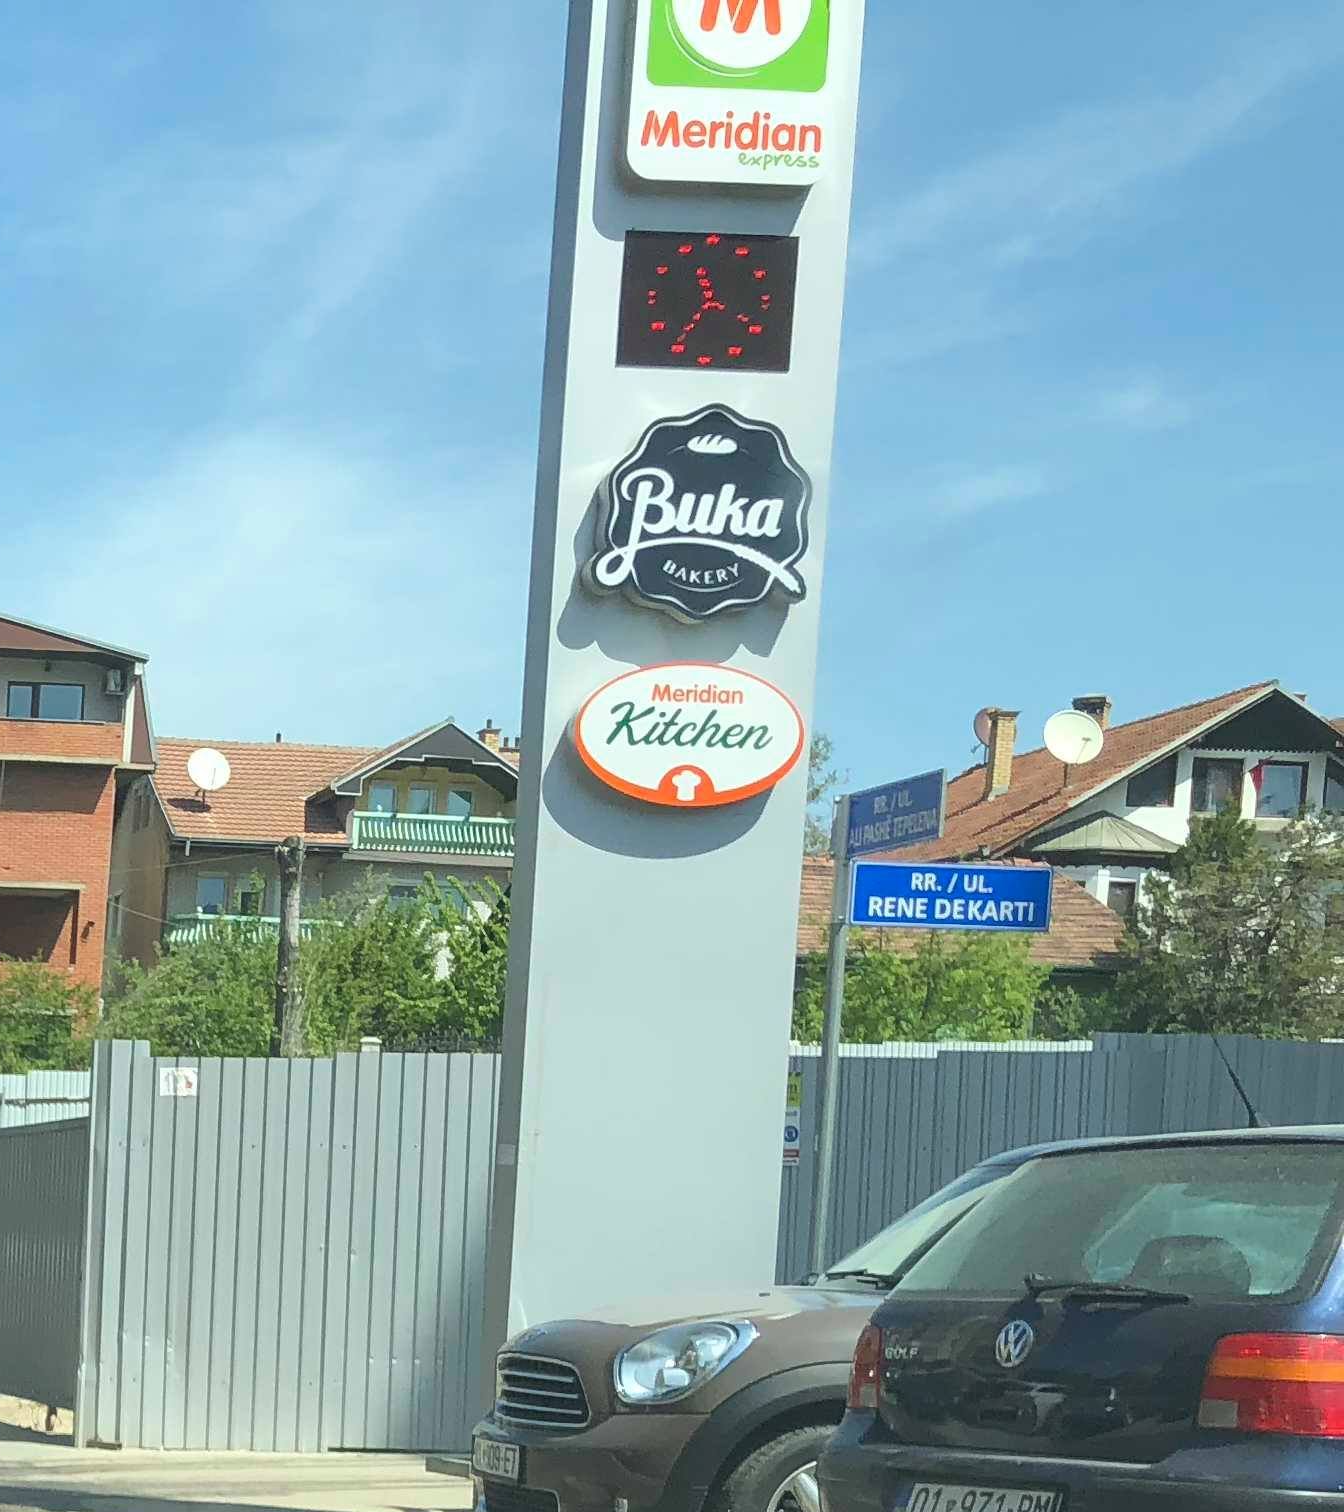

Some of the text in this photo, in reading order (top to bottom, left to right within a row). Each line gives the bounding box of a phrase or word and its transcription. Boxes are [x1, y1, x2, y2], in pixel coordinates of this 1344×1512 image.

[641, 110, 821, 152] Meridian
[738, 152, 820, 170] express
[596, 467, 784, 585] Buka
[662, 559, 739, 585] BAKERY
[651, 684, 744, 704] Meridian
[606, 701, 773, 750] Kitchen
[910, 872, 993, 893] RR. / UL.
[868, 896, 1034, 922] RENE DEKARTI
